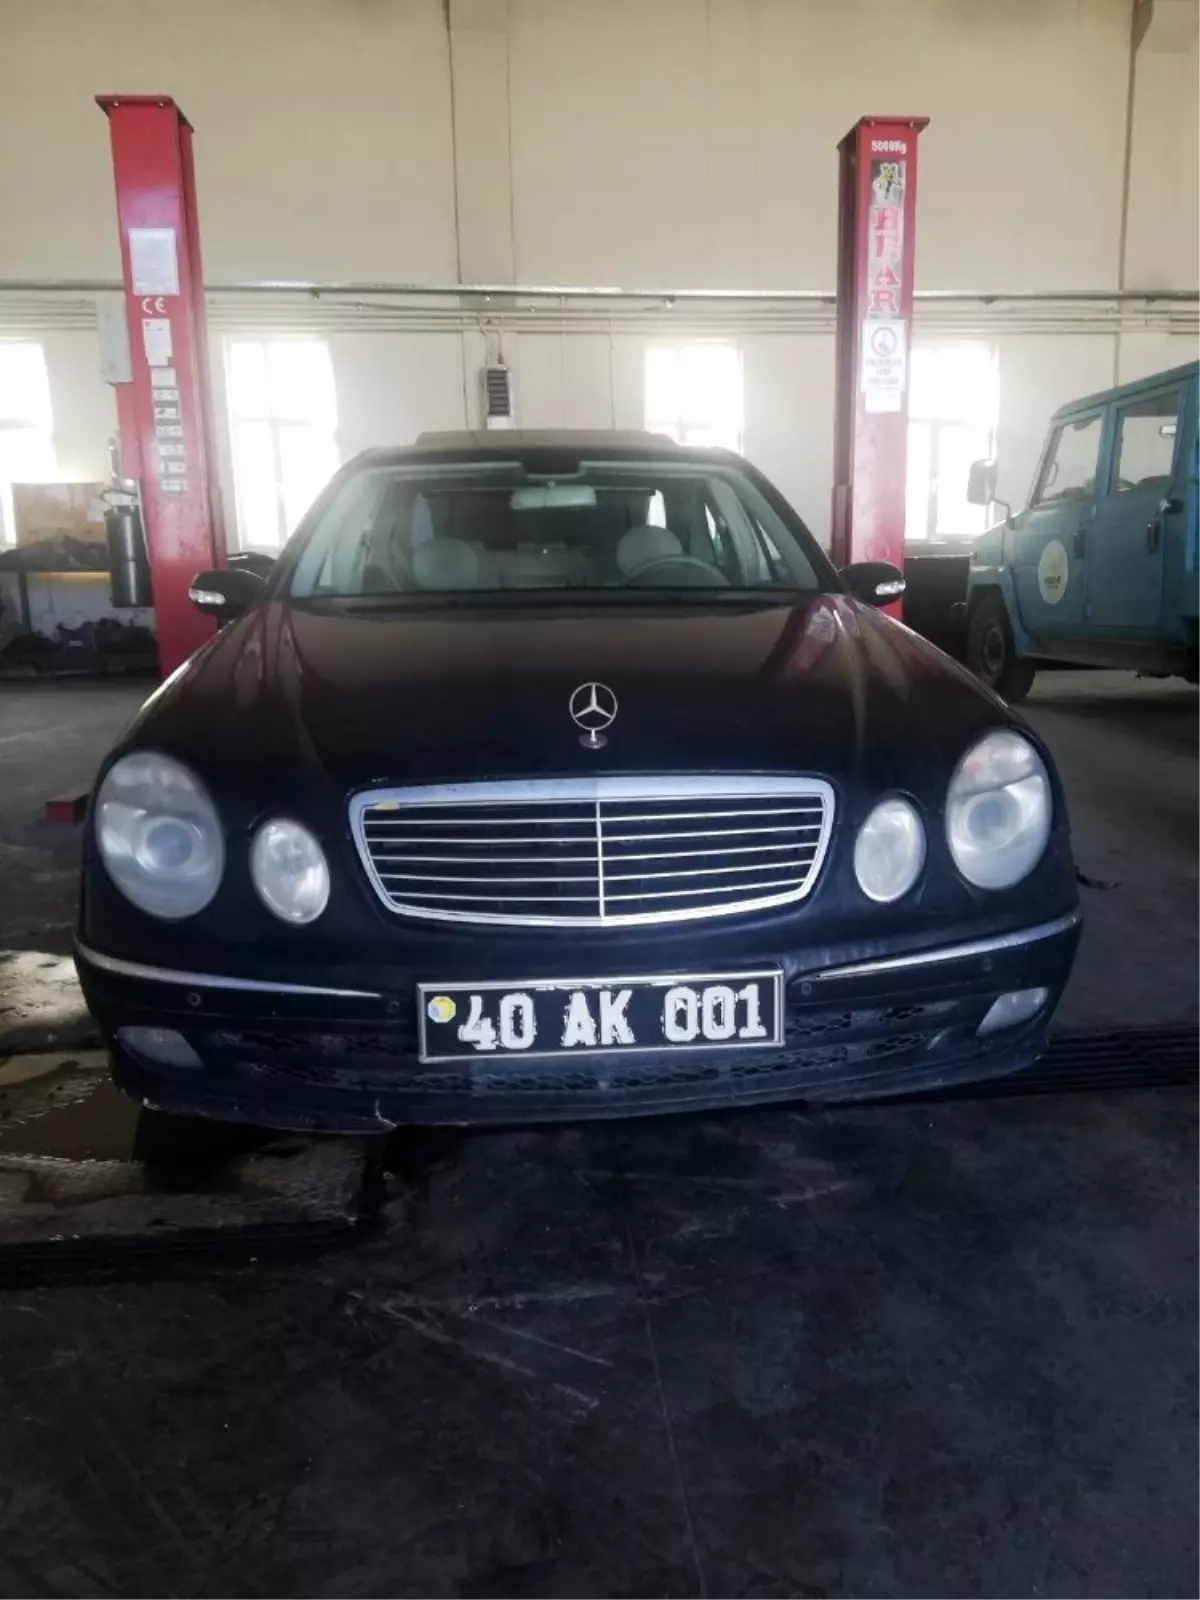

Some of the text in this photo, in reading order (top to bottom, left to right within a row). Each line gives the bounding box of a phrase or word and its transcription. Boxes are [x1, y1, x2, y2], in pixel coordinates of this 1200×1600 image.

[141, 297, 166, 314] CE
[457, 983, 767, 1050] 40 AK 001
